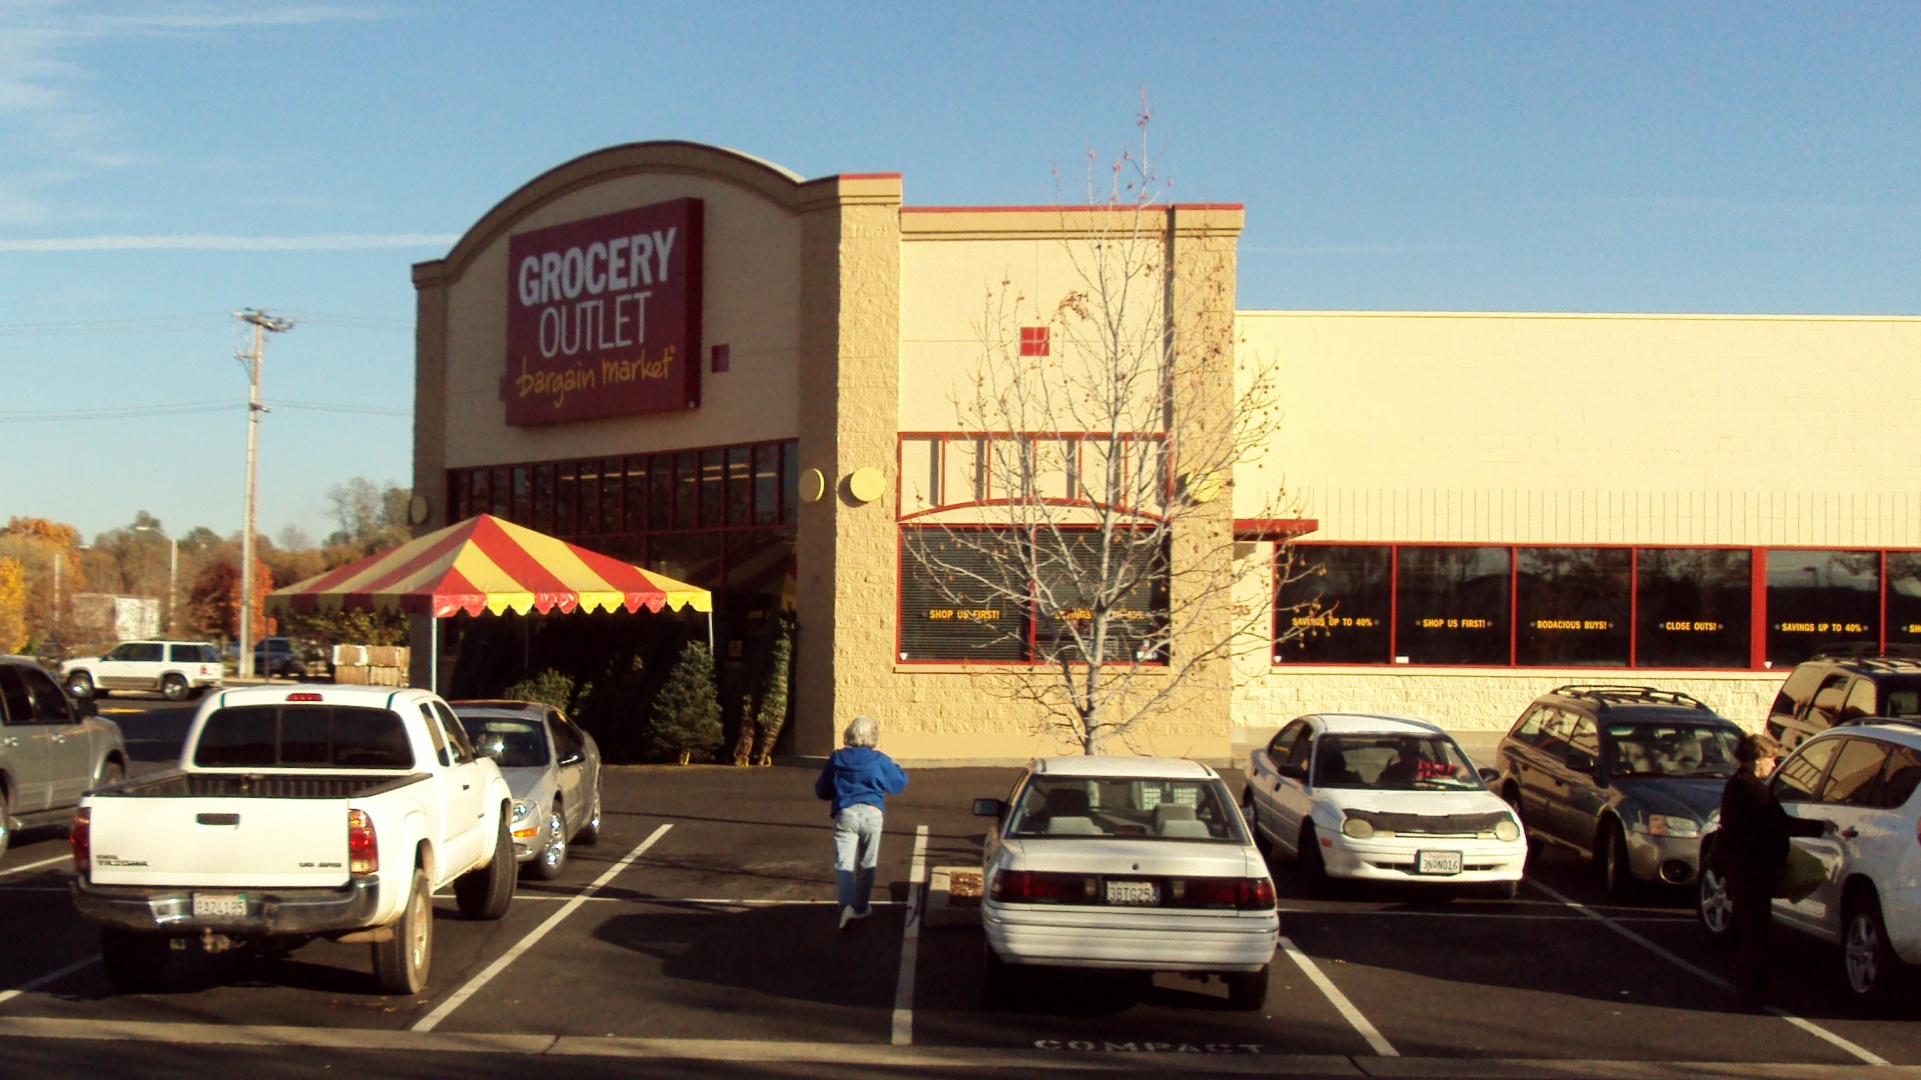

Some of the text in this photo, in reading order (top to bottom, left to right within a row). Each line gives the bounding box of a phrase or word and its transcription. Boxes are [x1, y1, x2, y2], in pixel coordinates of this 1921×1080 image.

[518, 226, 678, 307] GROCERY
[539, 291, 653, 359] OUTLET
[515, 348, 674, 409] bargain market
[929, 609, 1000, 620] SHOP US FIRST!
[1292, 617, 1373, 627] SAVINGS UP TO 40%
[1423, 618, 1486, 629] SHOP US FIRST!
[1537, 620, 1607, 630] BODACIOUS BUYS!
[1666, 621, 1717, 631] CLOSE OUTS!
[1782, 622, 1862, 632] SAVINGS UP TO 40%
[1034, 1039, 1263, 1054] COMPACT
